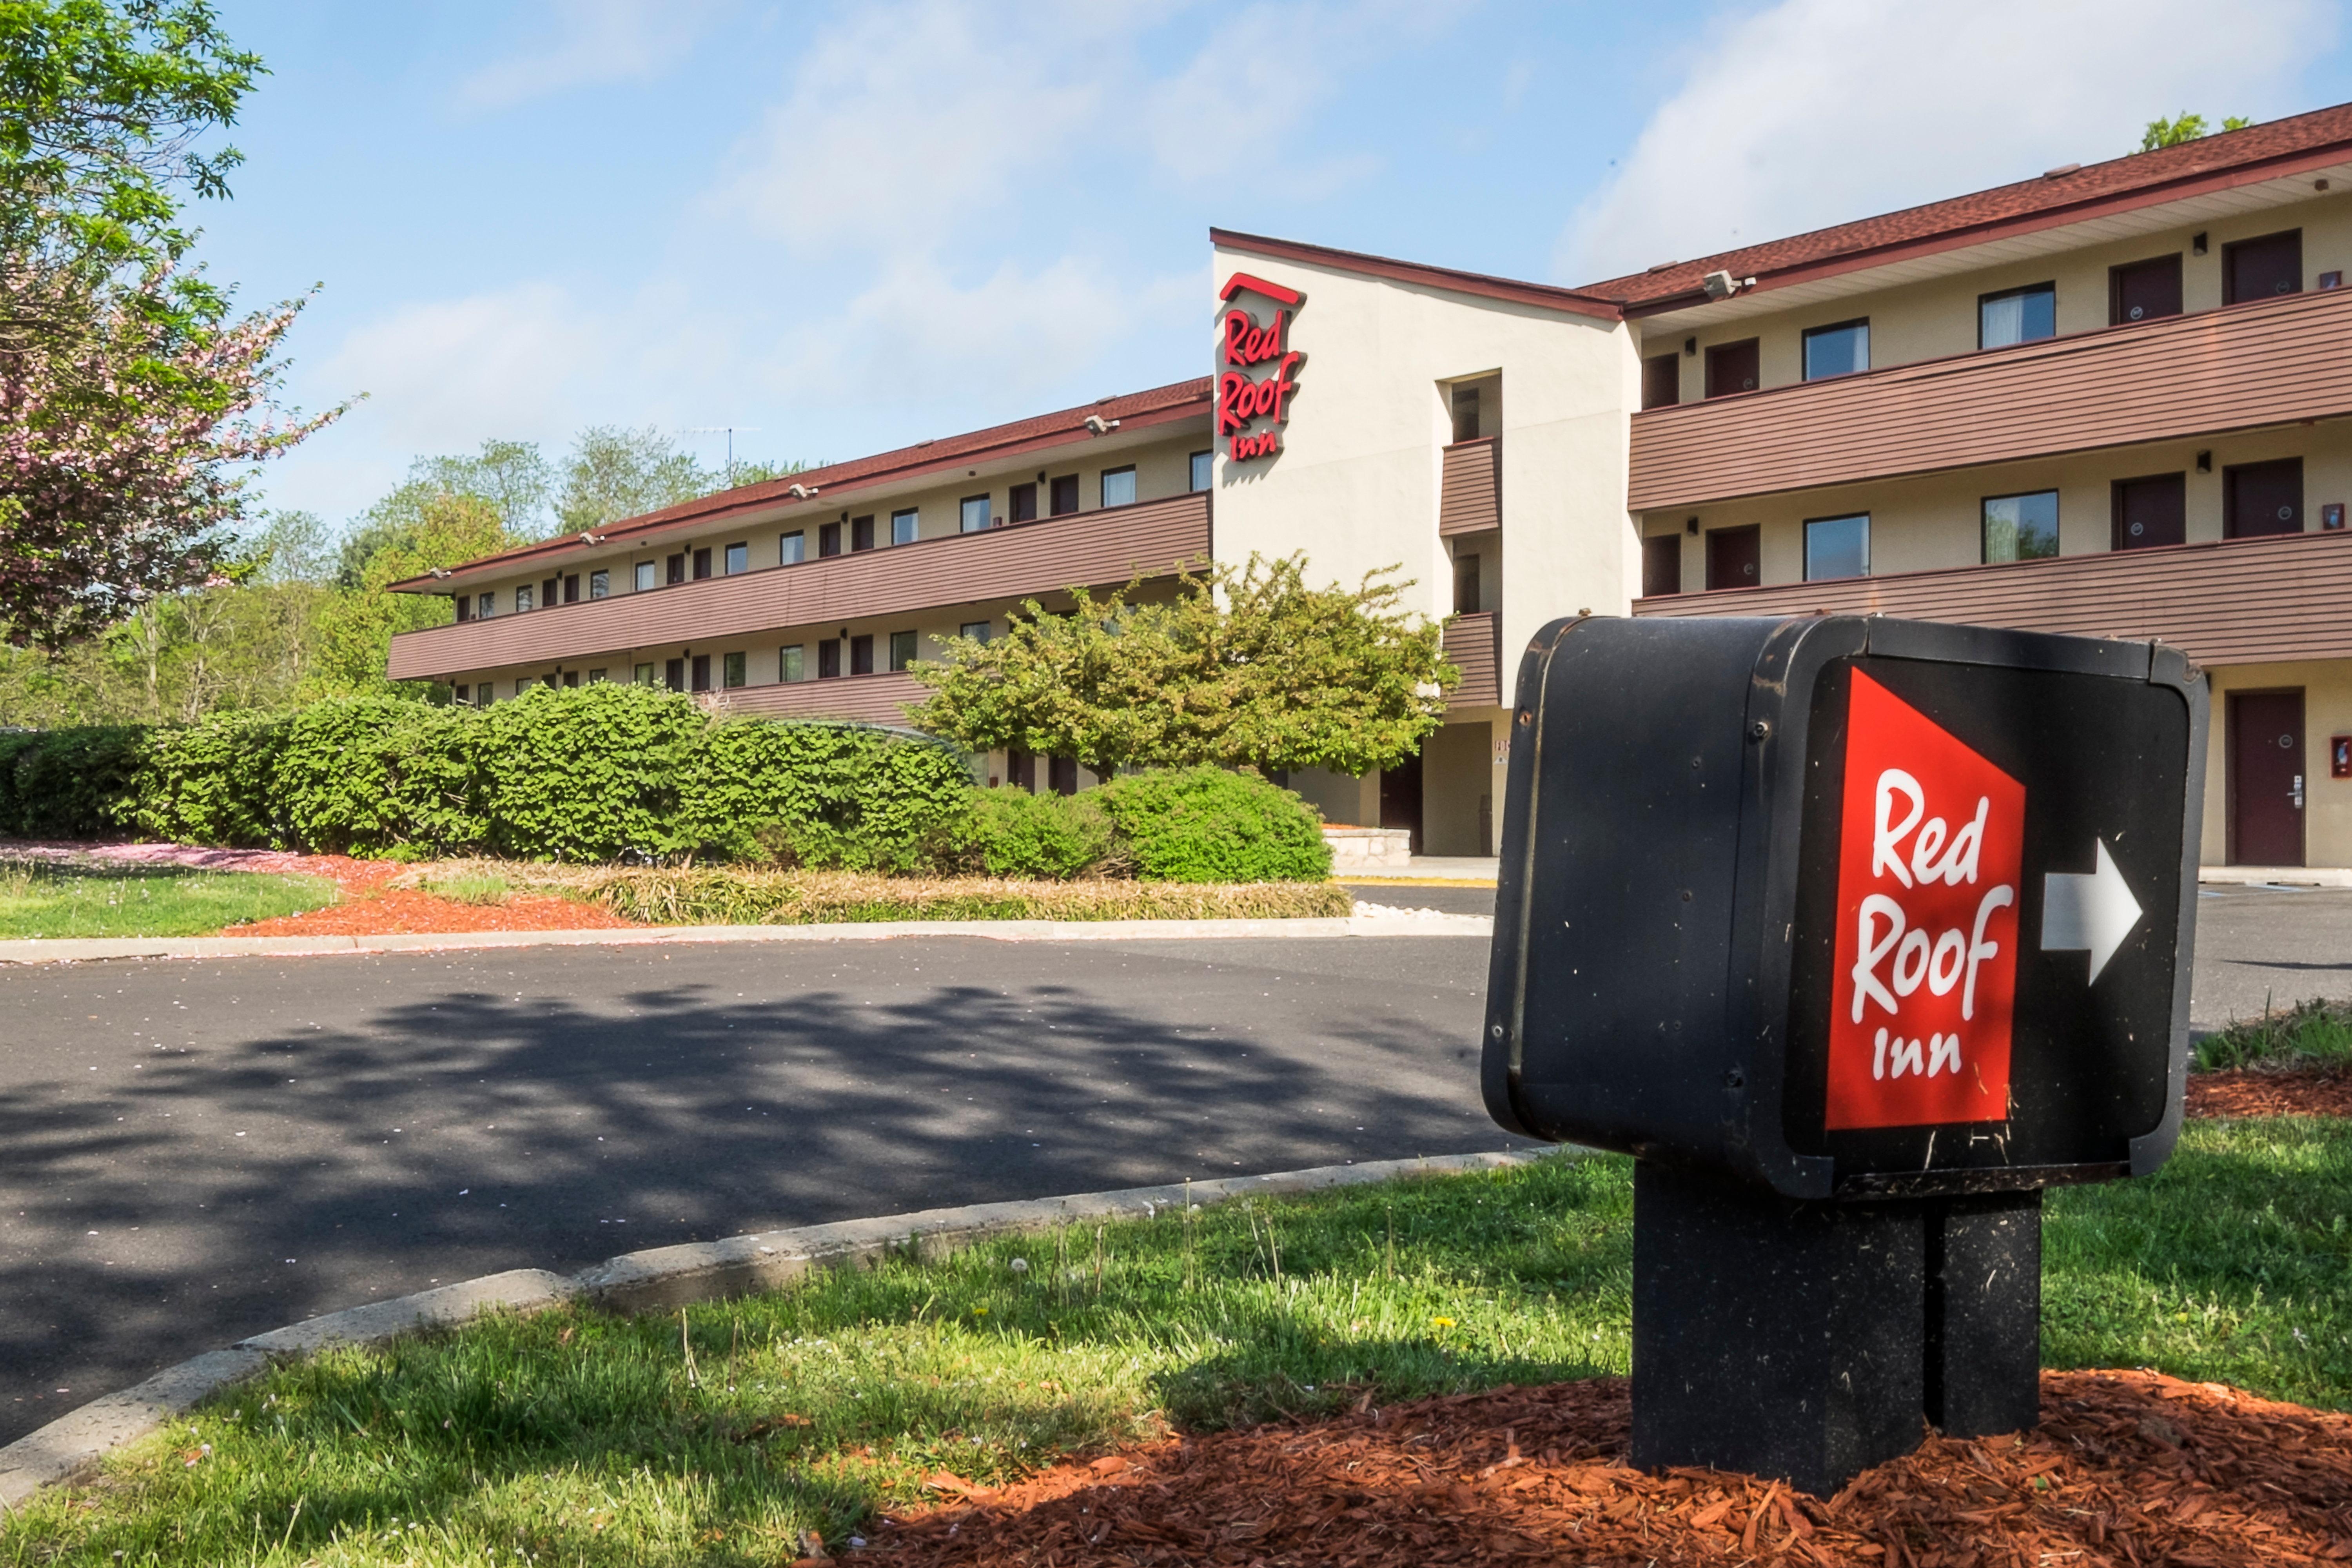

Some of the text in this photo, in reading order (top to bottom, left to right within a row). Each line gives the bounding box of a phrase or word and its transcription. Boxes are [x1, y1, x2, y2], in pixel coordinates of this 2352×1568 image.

[1224, 309, 1283, 366] Red
[1217, 351, 1300, 436] Roof
[1229, 432, 1277, 461] Inn
[1872, 768, 1989, 889] Red
[1851, 885, 2013, 1024] Roof
[1873, 1027, 1961, 1080] Inn
